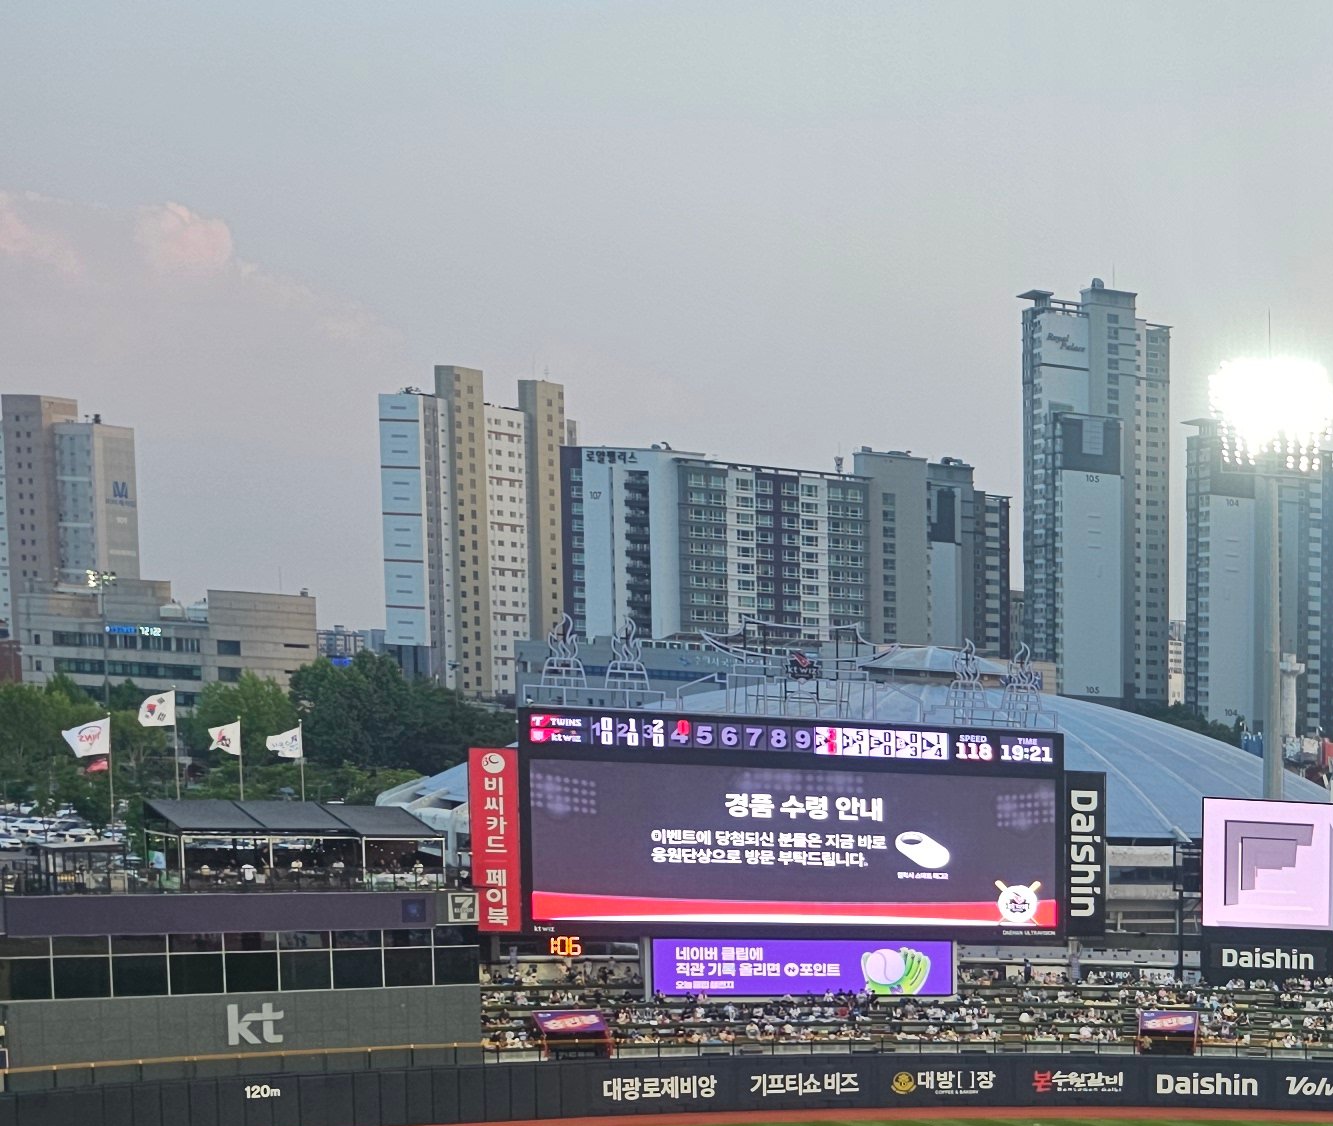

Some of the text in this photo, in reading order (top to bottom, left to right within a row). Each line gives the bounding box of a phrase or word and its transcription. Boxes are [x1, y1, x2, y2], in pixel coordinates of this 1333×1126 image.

[1086, 474, 1100, 483] 105
[589, 491, 602, 500] 107
[1225, 498, 1239, 507] 104
[1086, 686, 1100, 694] 105
[550, 717, 582, 727] TWINS
[696, 726, 713, 745] 5
[721, 728, 737, 746] 6
[746, 729, 762, 747] 7
[770, 730, 787, 749] 8
[795, 731, 811, 749] 9
[959, 734, 988, 743] SPEED
[1017, 737, 1038, 746] TIME
[956, 742, 993, 761] 118
[1000, 744, 1054, 763] 19:21
[484, 777, 508, 853] 비씨카드
[725, 793, 884, 822] 경품 수령 안내
[651, 829, 888, 850] 이벤트에 당첨되신 분들은 지금 바로
[651, 847, 742, 865] 응원단상으로
[744, 849, 776, 865] 방문
[1070, 790, 1100, 917] Daishin
[486, 869, 509, 926] 페이북
[675, 946, 718, 961] 네이버
[1221, 948, 1314, 970] Daishin
[675, 962, 780, 977] 직관 기록 올리면
[226, 1002, 284, 1046] kt
[244, 1084, 281, 1098] 120m
[602, 1073, 718, 1101] 대광로제비앙
[749, 1071, 860, 1097] 기프티쇼 비즈
[1156, 1072, 1259, 1096] Daishin
